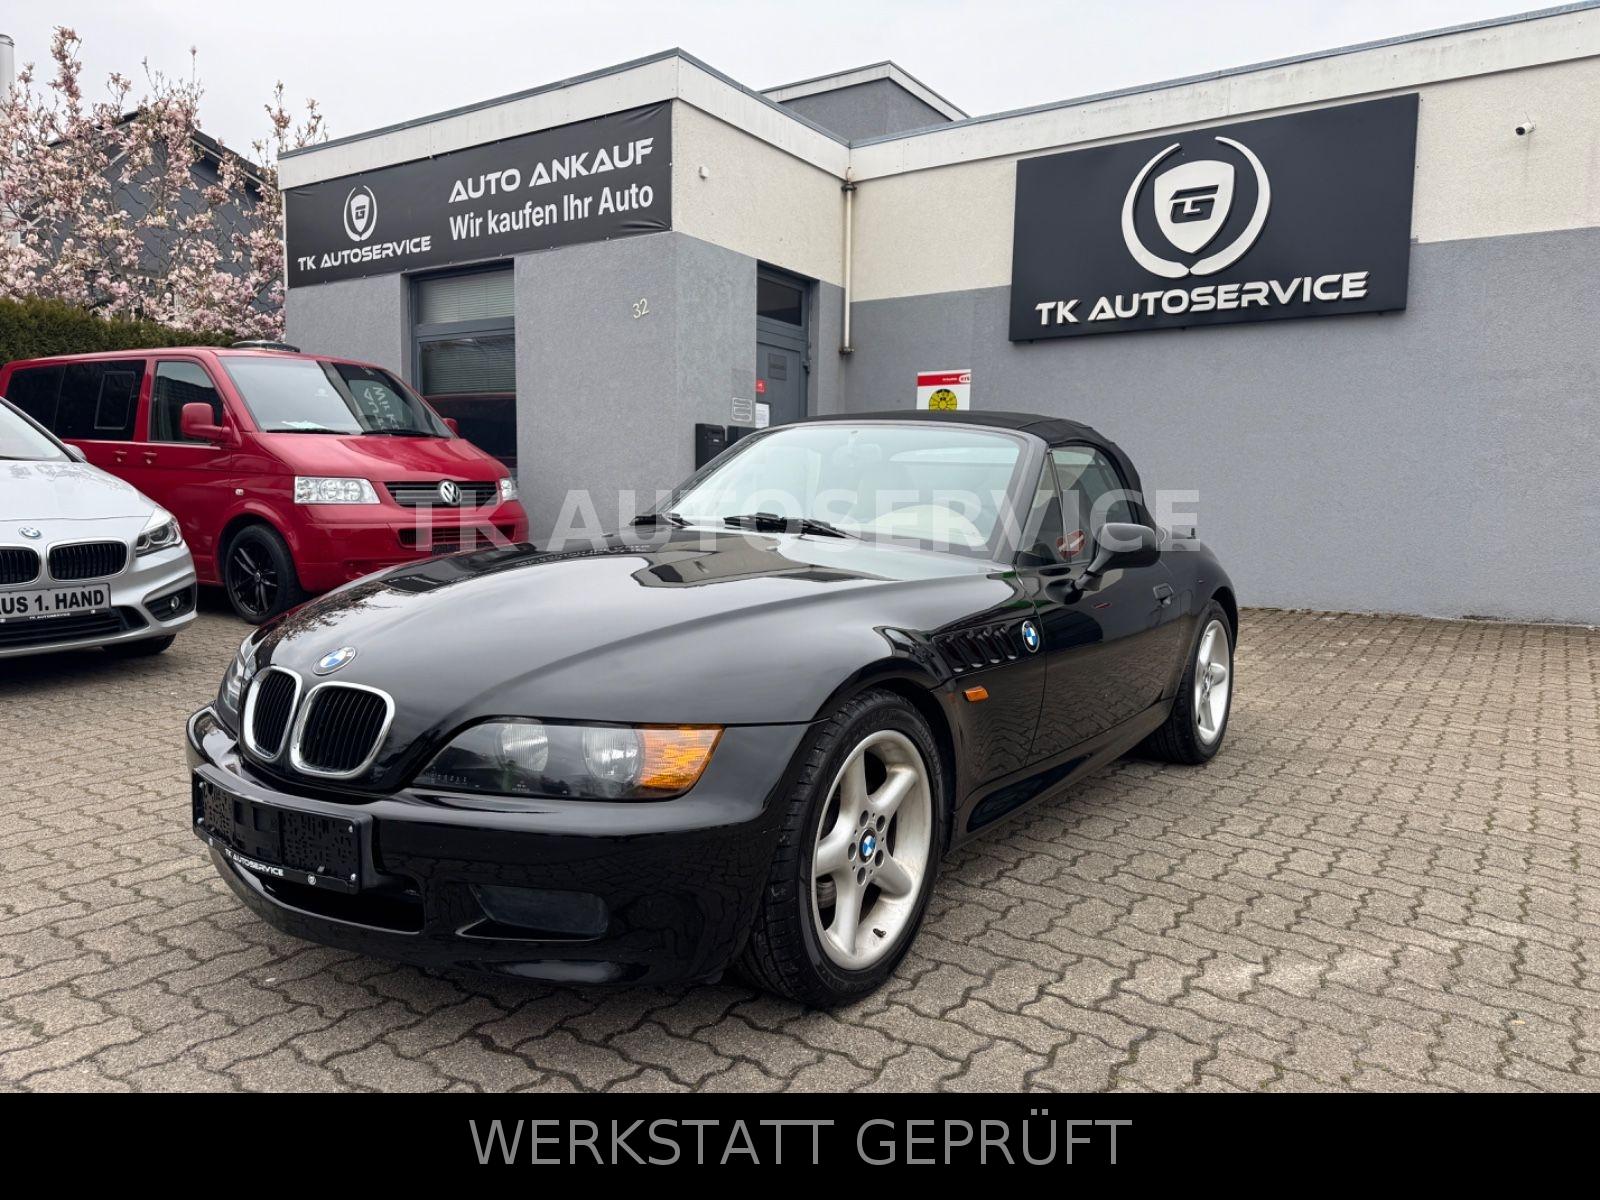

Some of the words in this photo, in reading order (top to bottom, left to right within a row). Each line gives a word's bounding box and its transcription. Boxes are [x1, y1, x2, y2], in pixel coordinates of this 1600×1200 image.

[448, 168, 521, 203] AUTO
[529, 137, 654, 187] ANKAUF
[449, 213, 483, 240] Wir
[488, 200, 558, 235] kaufen
[563, 192, 593, 222] Ihr
[598, 184, 654, 214] Auto
[298, 254, 317, 271] TK
[320, 235, 432, 268] AUTOSERVICE
[632, 298, 650, 319] 32
[1035, 299, 1082, 325] TK
[1087, 271, 1370, 322] AUTOSERVICE
[0, 596, 28, 614] US
[34, 594, 50, 611] 1.
[55, 589, 104, 609] HAND
